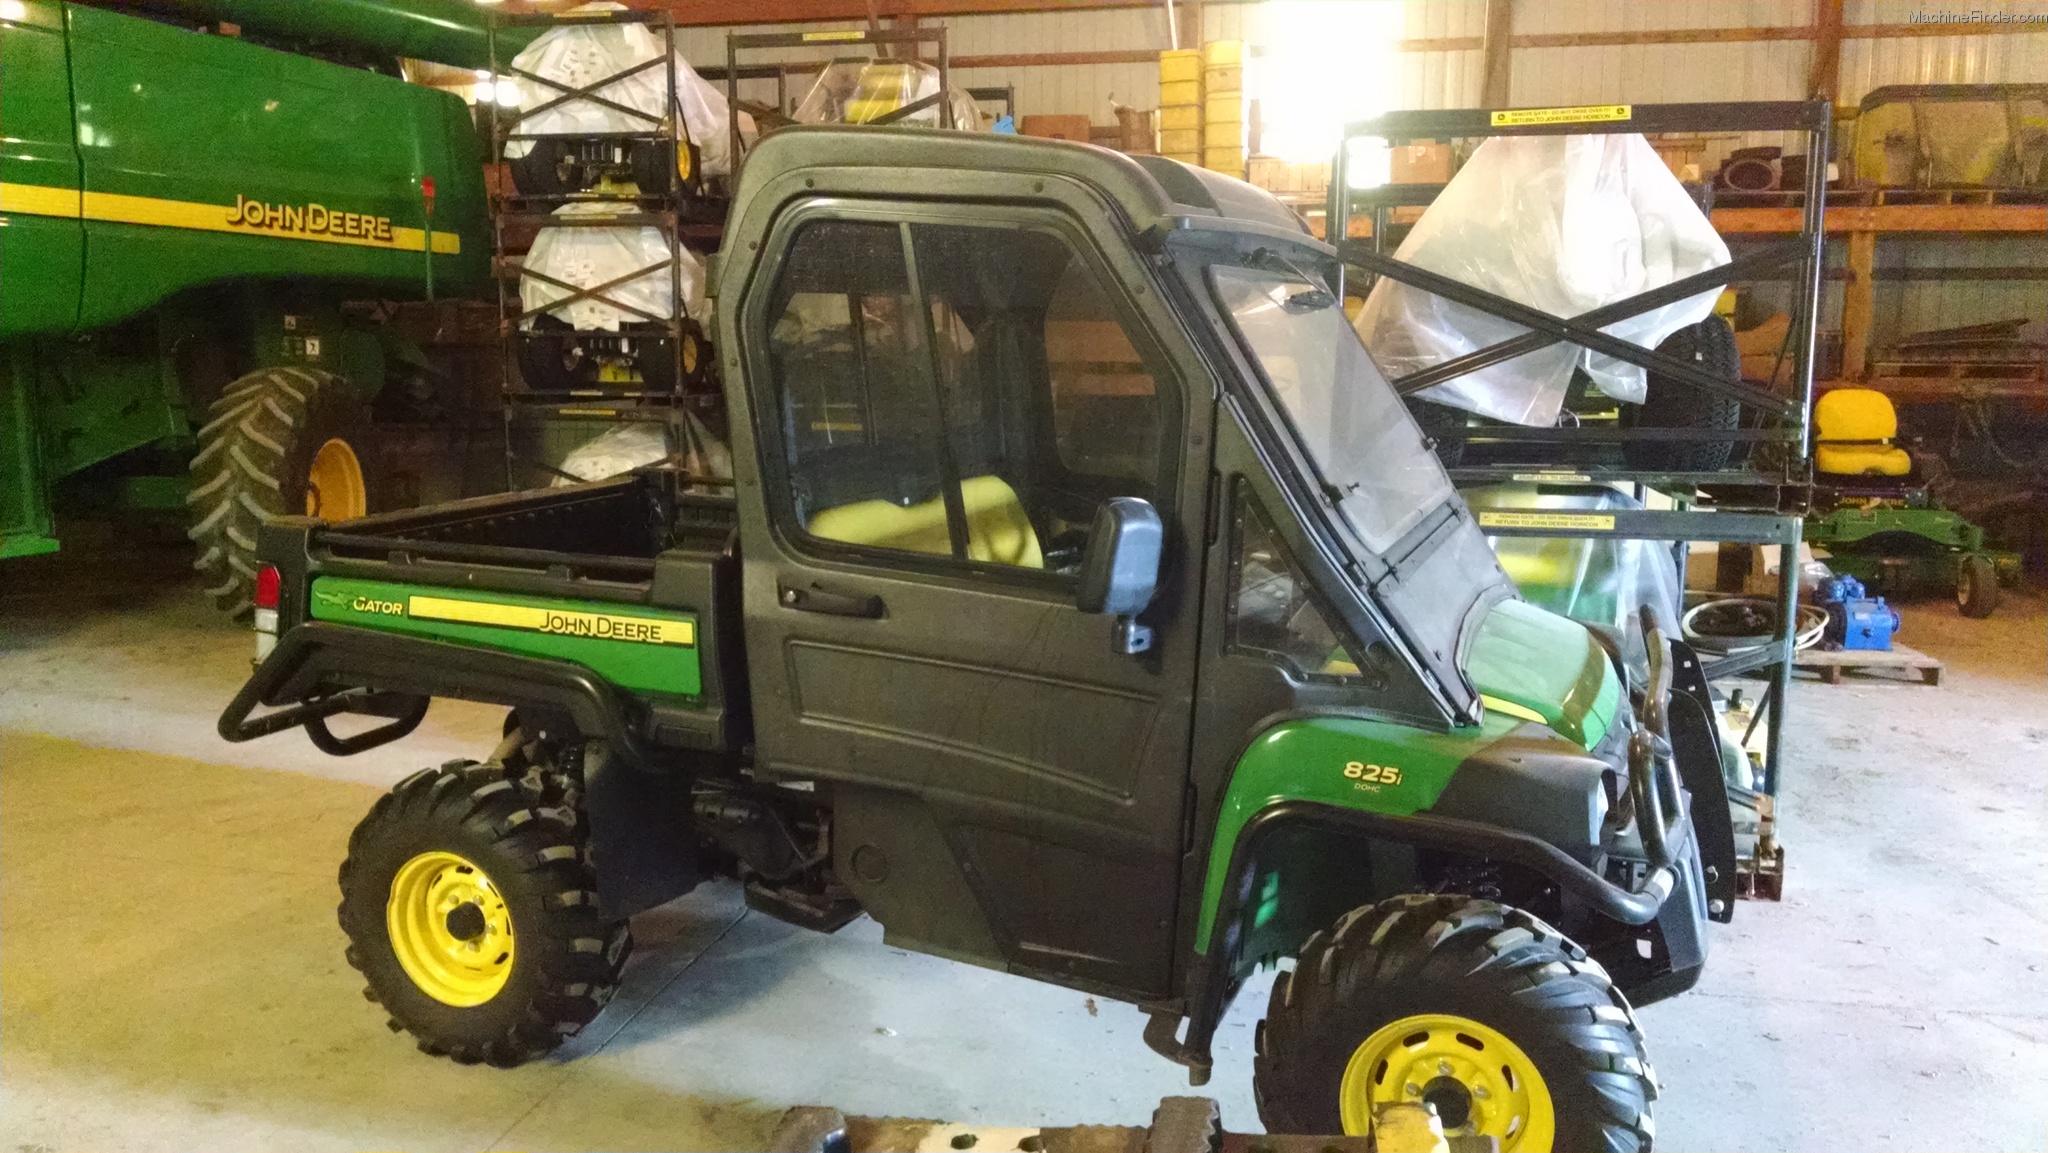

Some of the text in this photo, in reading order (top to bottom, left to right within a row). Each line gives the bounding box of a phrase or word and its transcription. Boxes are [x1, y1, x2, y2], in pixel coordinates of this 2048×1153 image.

[227, 194, 393, 242] JOHN DEERE
[353, 597, 403, 615] GATOR
[540, 612, 662, 640] JOHN DEERE
[1343, 761, 1403, 785] 825i
[1354, 782, 1381, 793] DOHC
